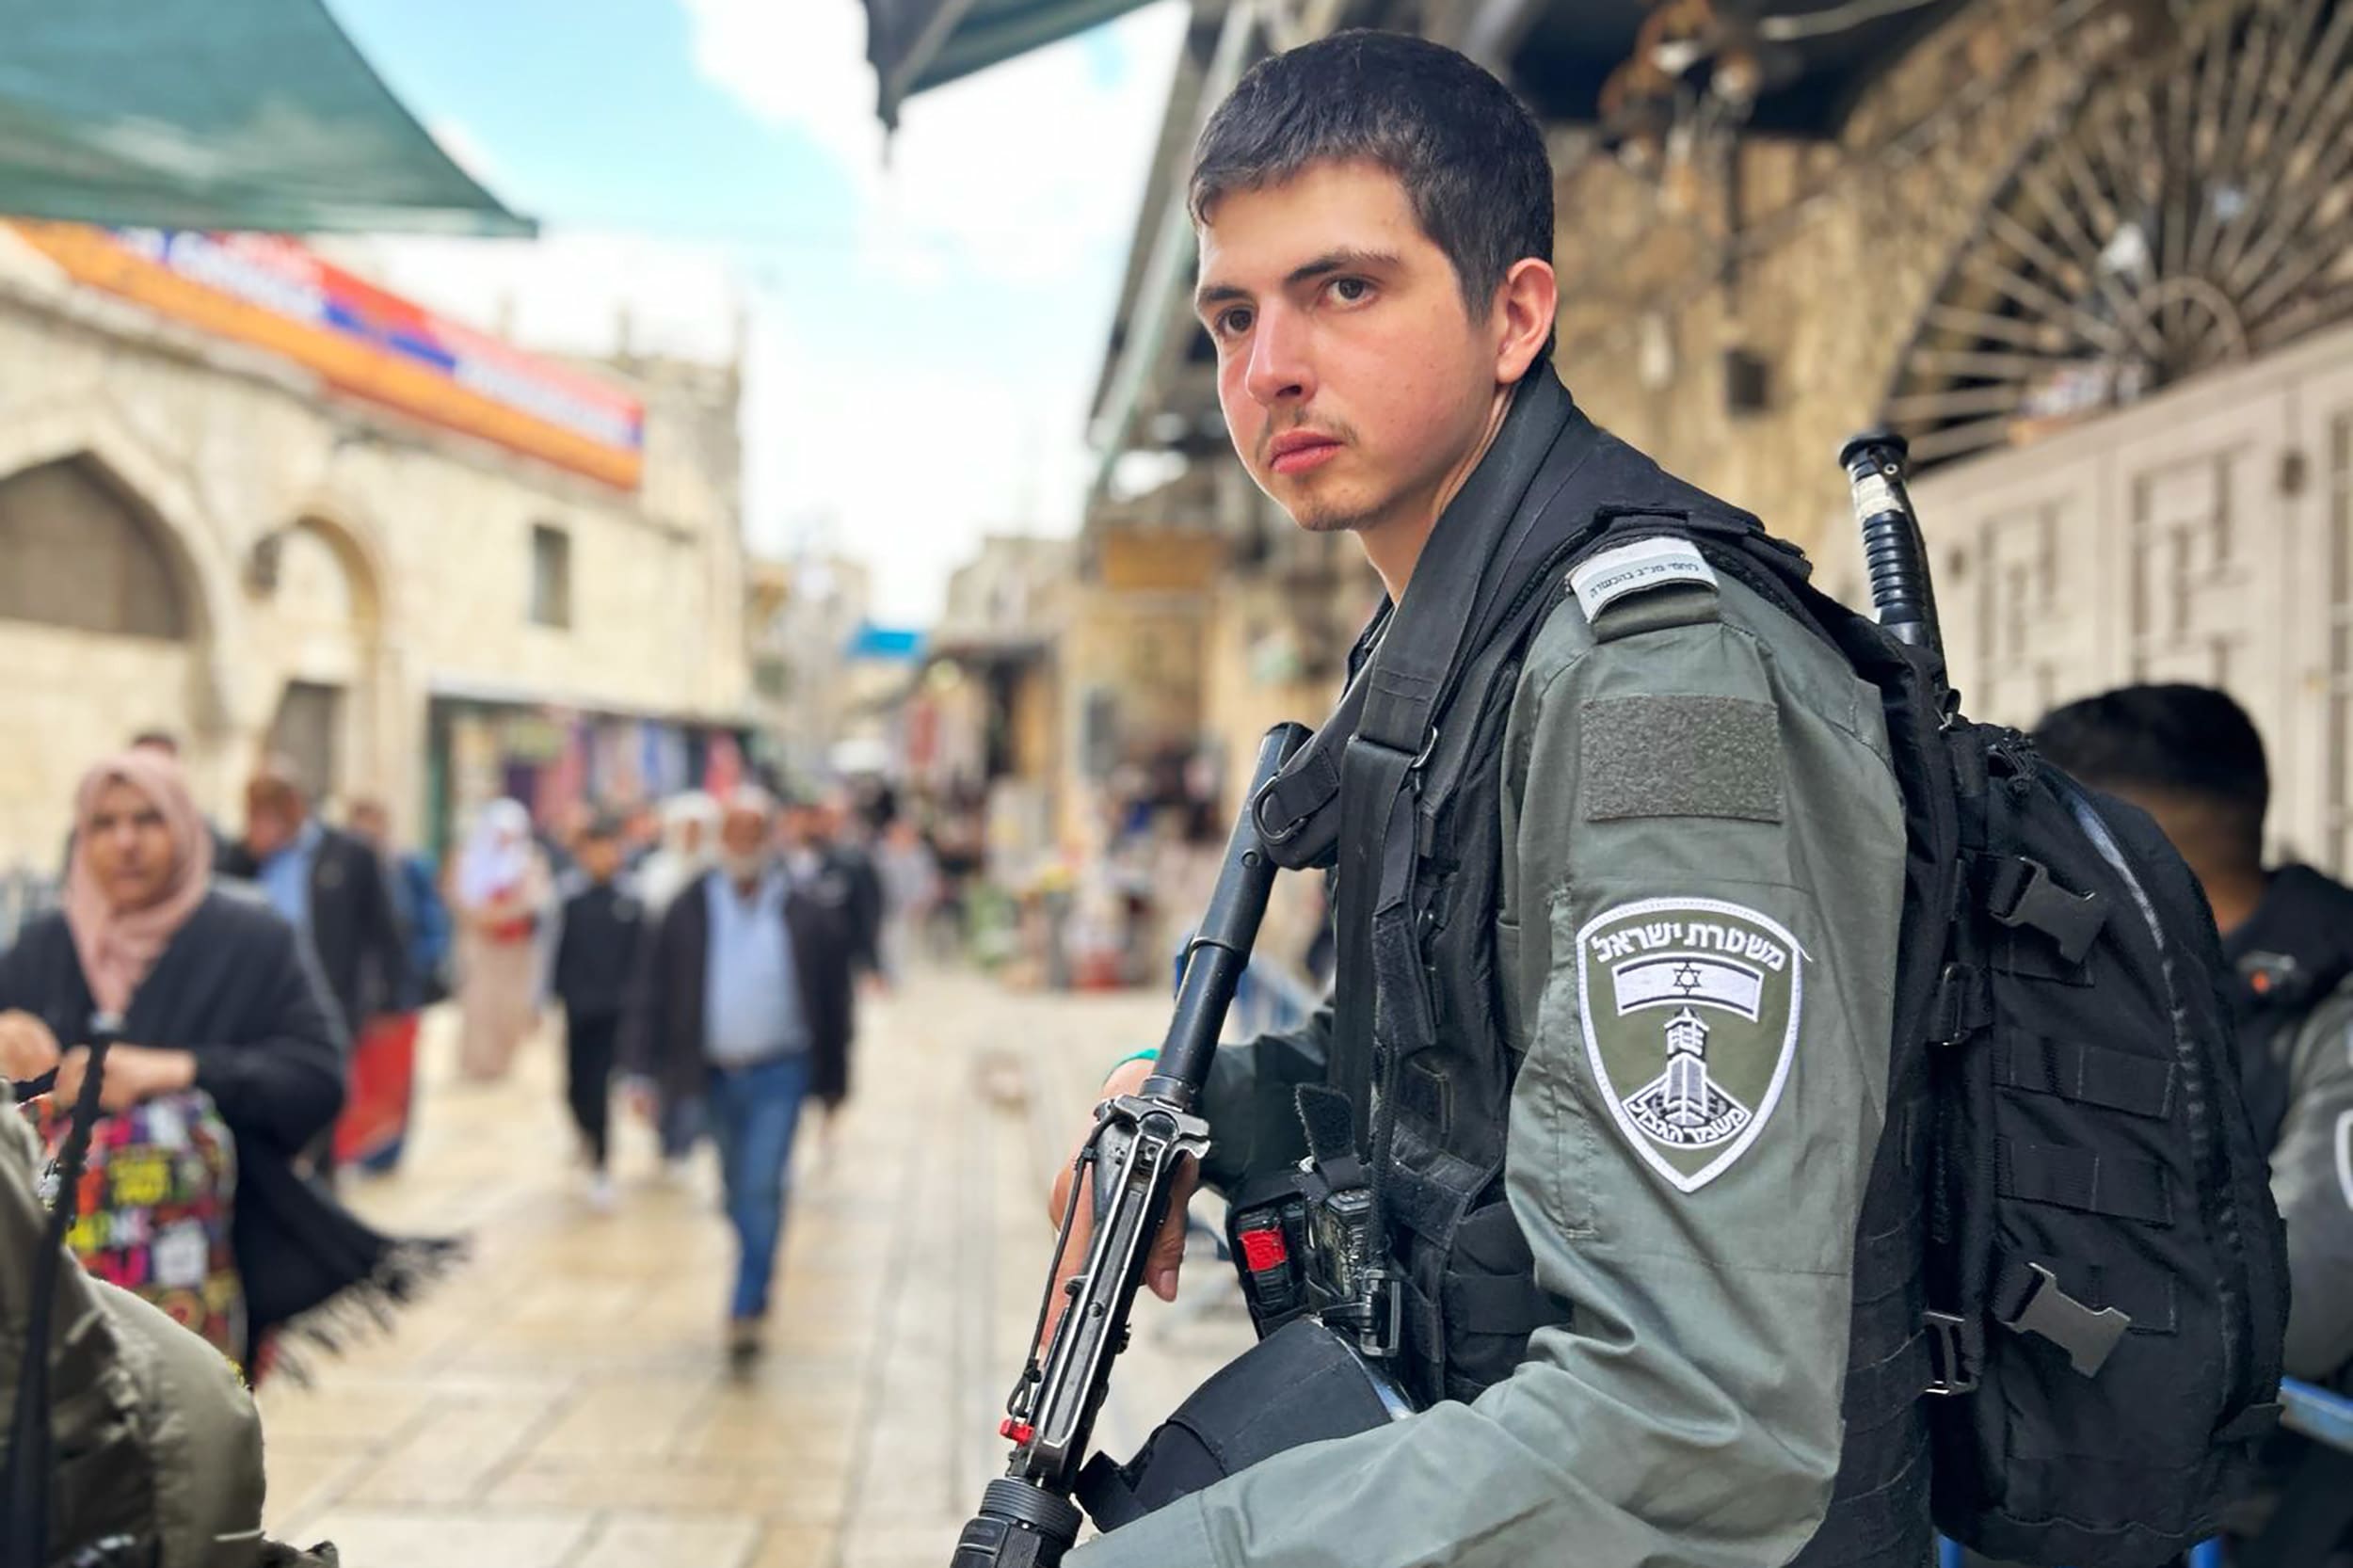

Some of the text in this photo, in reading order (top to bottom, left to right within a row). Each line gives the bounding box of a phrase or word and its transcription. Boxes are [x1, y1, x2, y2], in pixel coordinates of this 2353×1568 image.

[1592, 922, 1785, 971] משטרת ישראל
[1683, 1107, 1745, 1144] משמר
